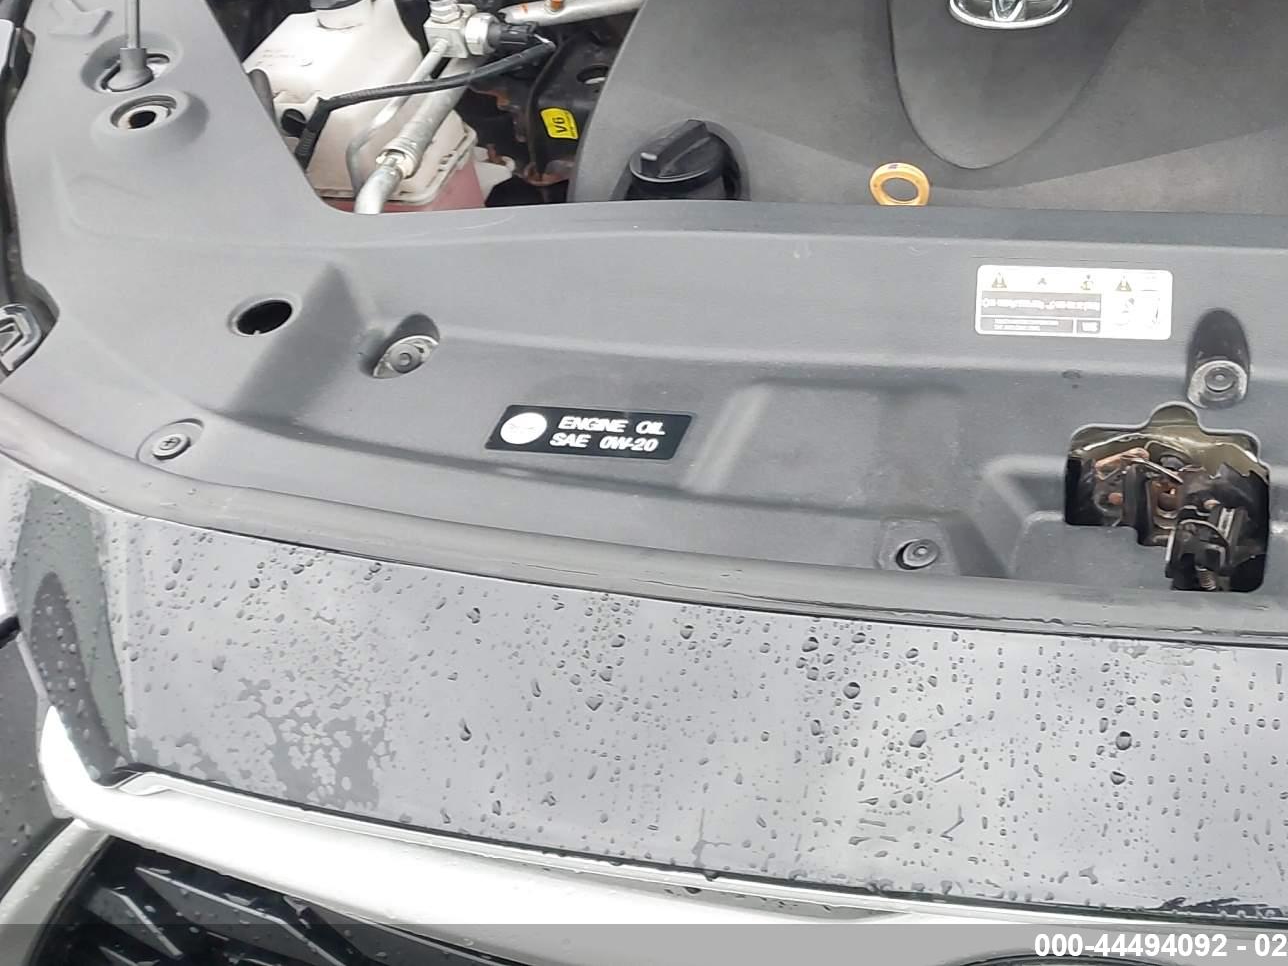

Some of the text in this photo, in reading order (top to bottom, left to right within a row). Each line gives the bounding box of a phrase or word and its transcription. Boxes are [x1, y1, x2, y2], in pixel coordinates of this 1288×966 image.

[558, 416, 666, 435] ENGINE OIL
[549, 433, 592, 448] SAE
